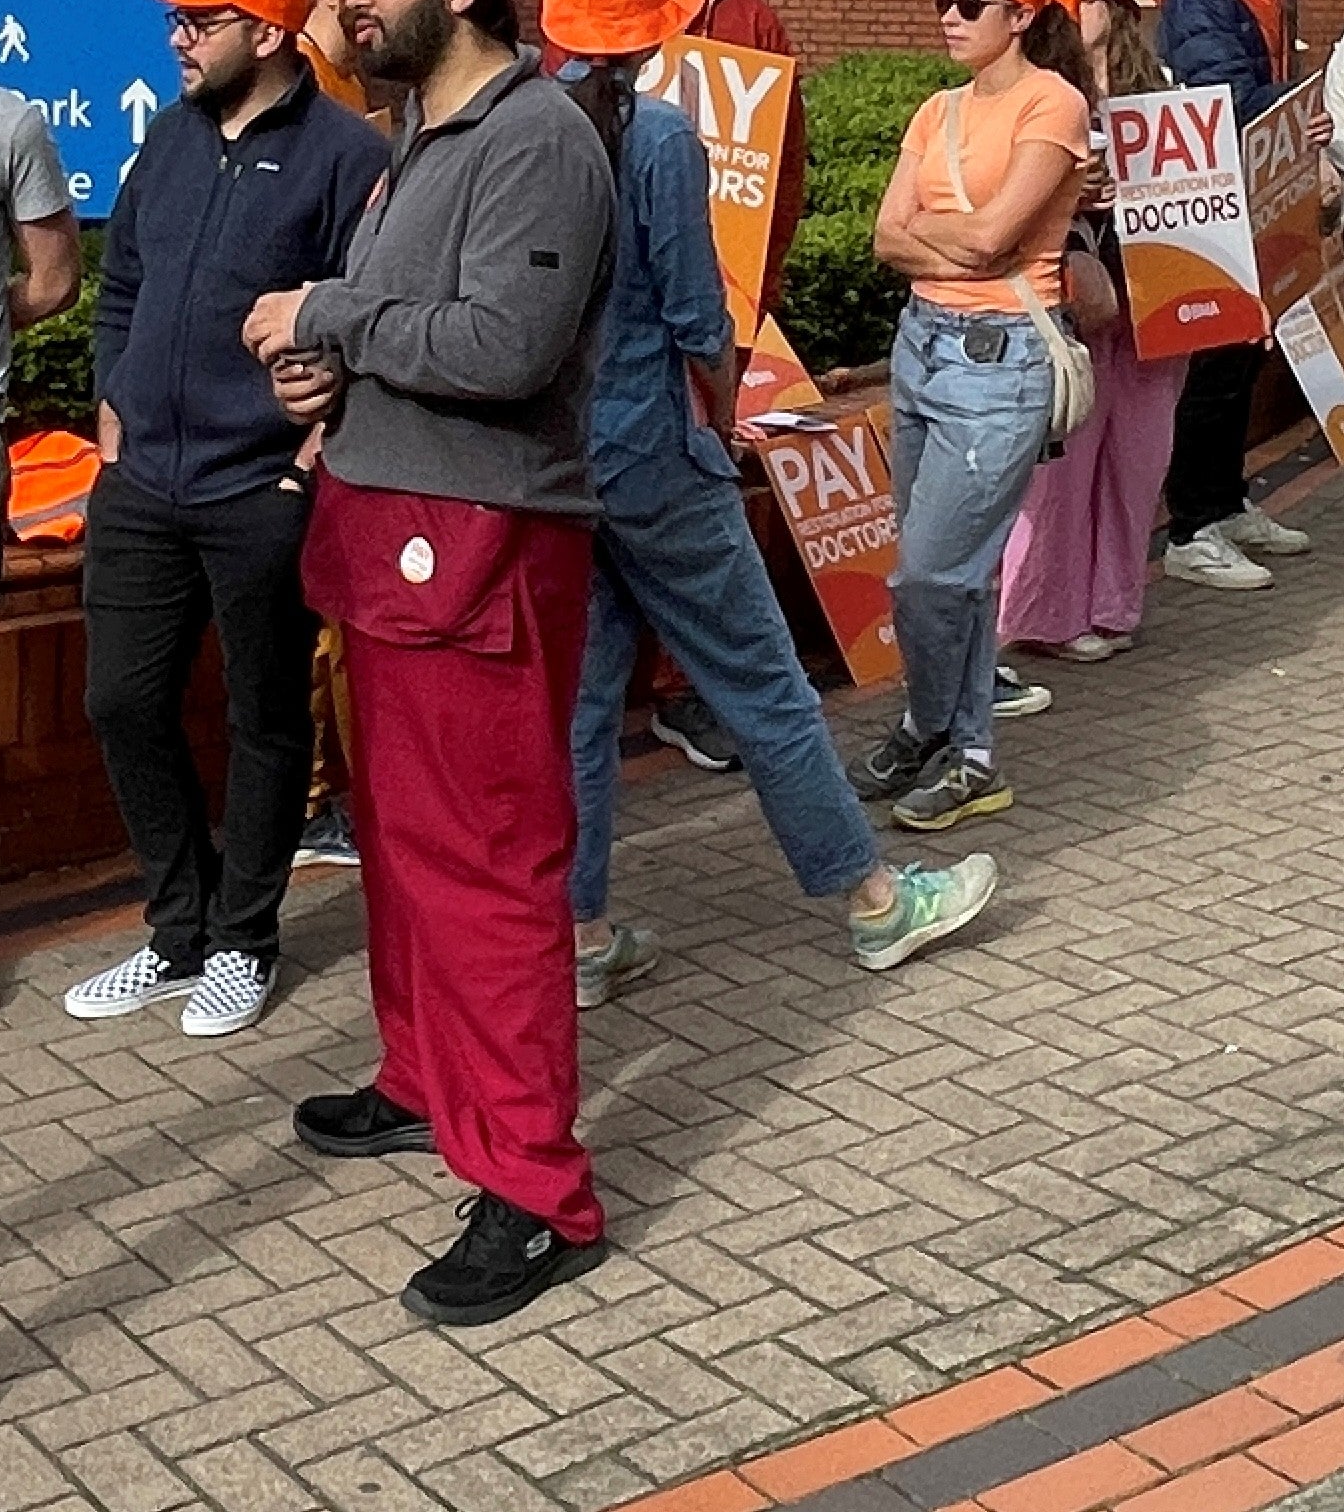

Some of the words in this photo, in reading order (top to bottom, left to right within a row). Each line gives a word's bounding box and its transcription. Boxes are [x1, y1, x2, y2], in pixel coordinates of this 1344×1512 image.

[731, 147, 769, 171] FOR
[1110, 98, 1224, 182] PAY
[1249, 90, 1318, 194] PAY
[1123, 192, 1240, 236] DOCTORS
[768, 426, 876, 518] PAY
